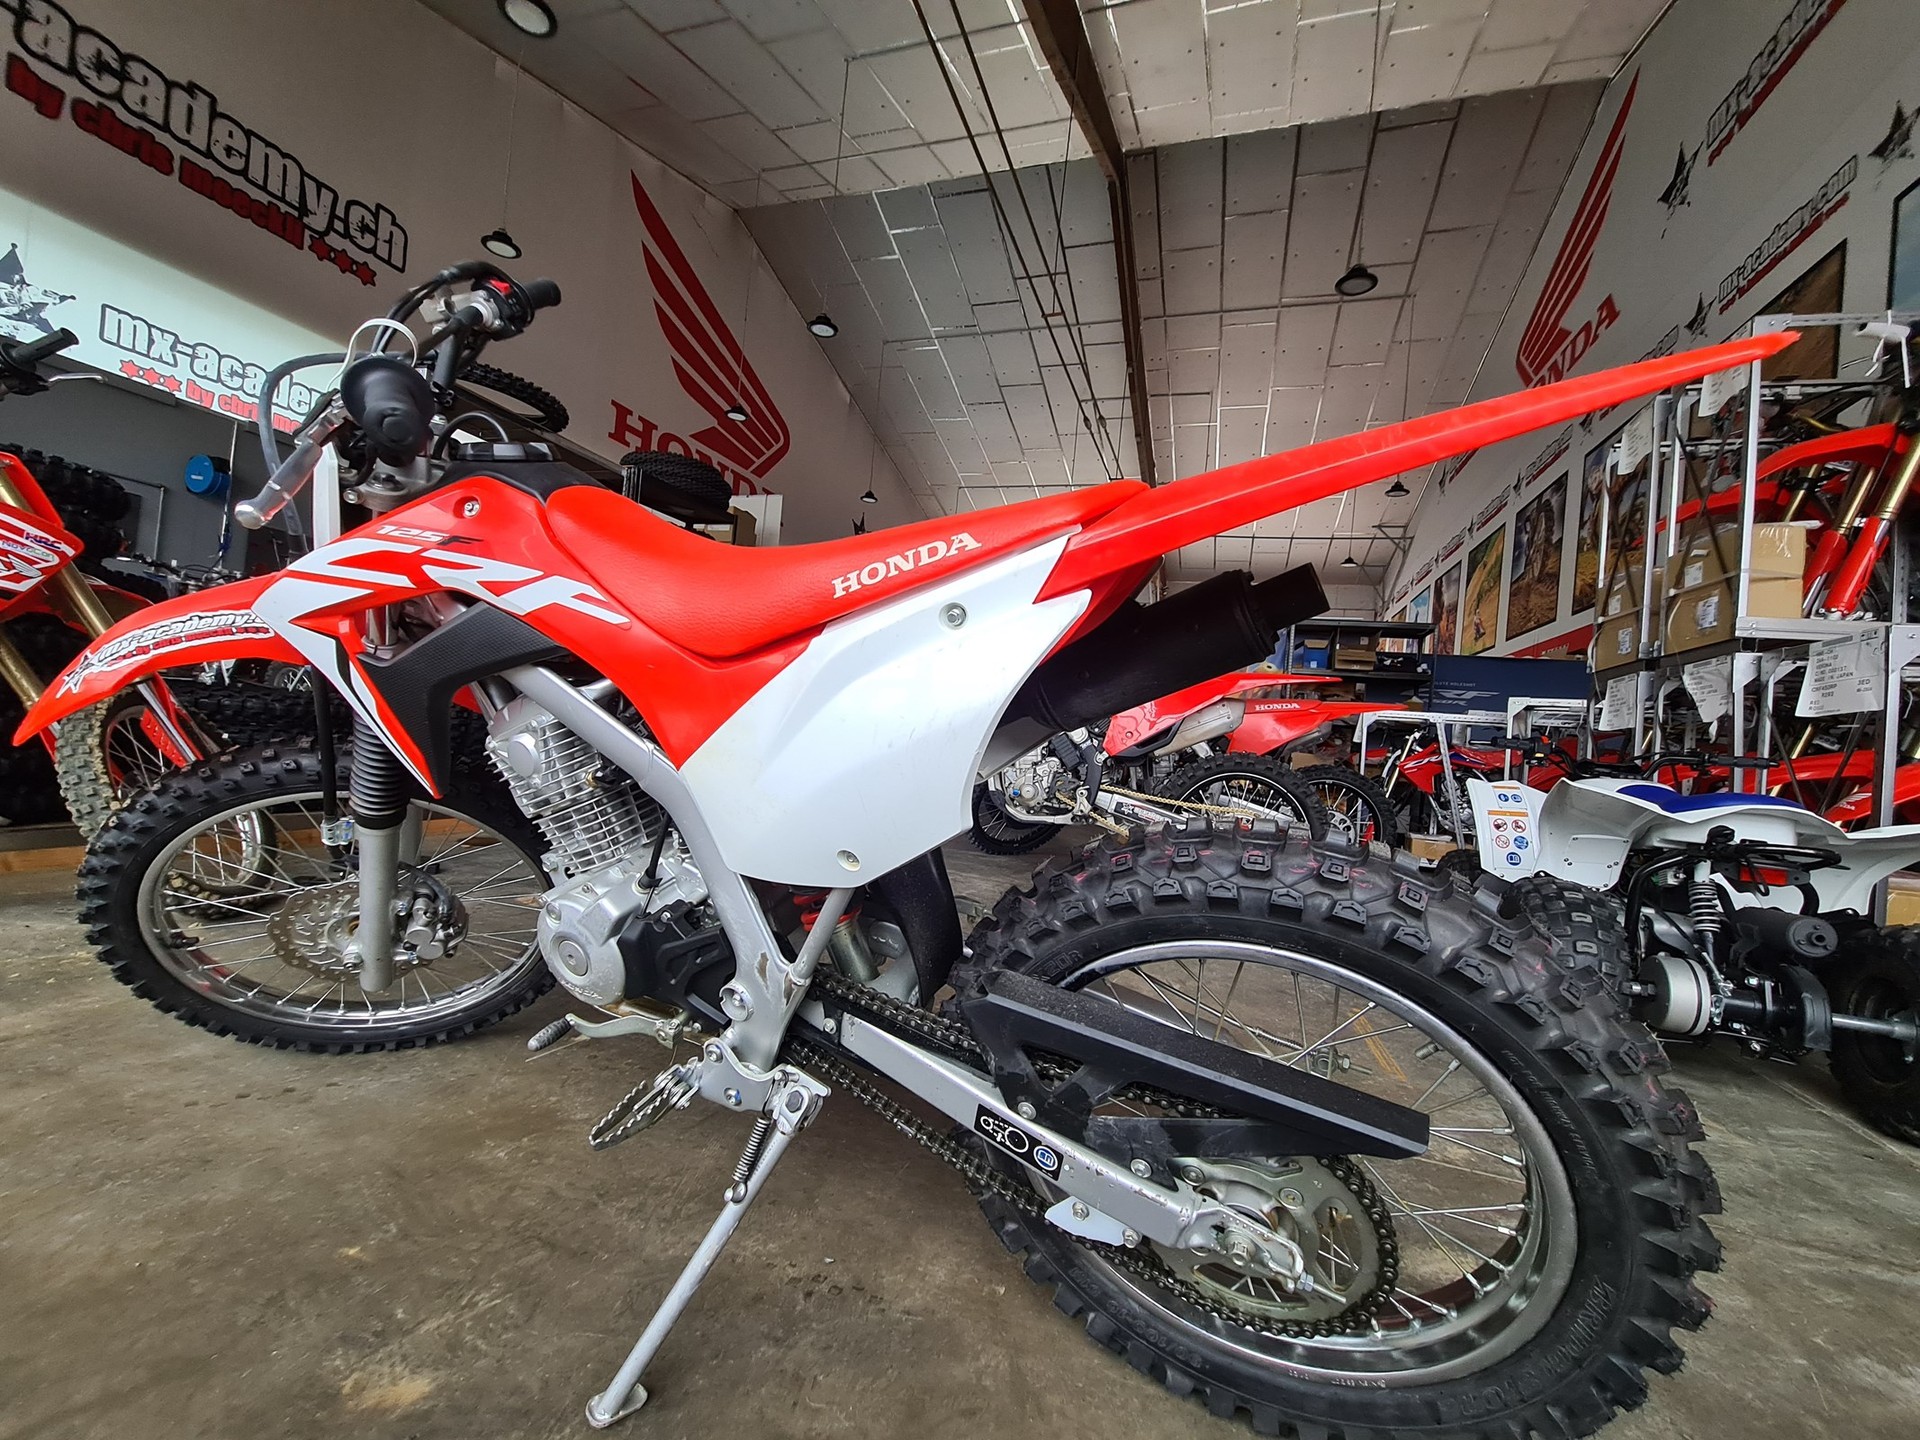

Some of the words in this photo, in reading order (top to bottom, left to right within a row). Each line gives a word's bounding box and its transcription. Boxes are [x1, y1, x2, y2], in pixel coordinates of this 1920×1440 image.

[70, 96, 175, 176] chris
[185, 378, 216, 410] by
[217, 393, 262, 422] chri
[374, 524, 484, 547] 125F
[831, 531, 982, 600] HONDA
[1255, 702, 1301, 711] HONDA
